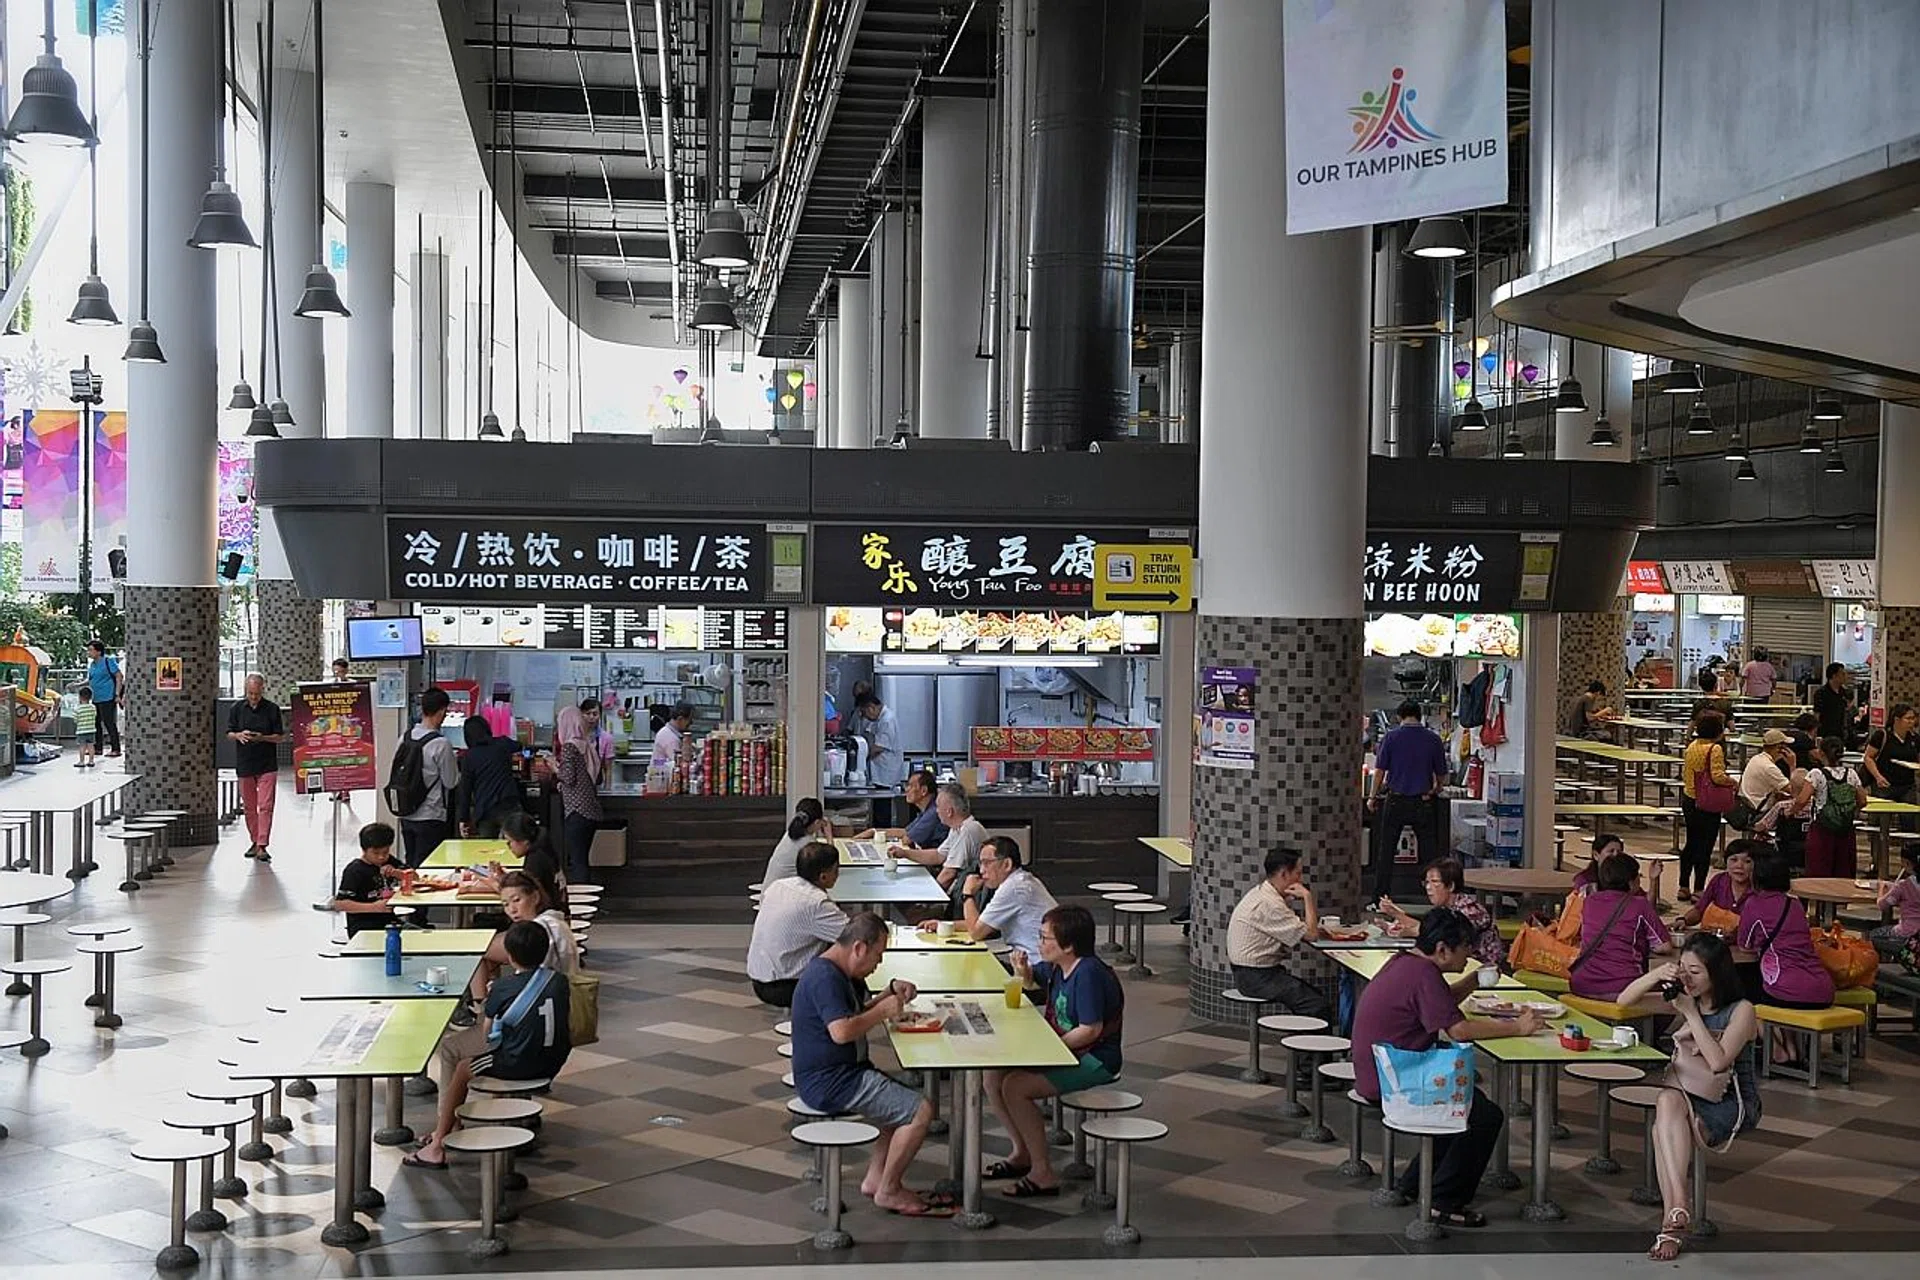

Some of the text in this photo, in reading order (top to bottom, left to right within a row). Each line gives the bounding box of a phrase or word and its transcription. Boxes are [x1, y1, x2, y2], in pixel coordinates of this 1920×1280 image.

[1297, 138, 1497, 186] OUR TAMPINES HUB
[1149, 553, 1175, 563] TRAY
[1143, 564, 1181, 573] RETURN
[405, 572, 749, 592] COLD/HOT BEVERAGE COFFEE/TEA
[927, 576, 970, 600] Yong
[975, 576, 1007, 594] Tau
[1015, 576, 1043, 593] Foo
[1142, 575, 1182, 584] STATION
[1383, 582, 1418, 601] BEE
[1425, 582, 1481, 602] HOON
[538, 998, 555, 1047] 1
